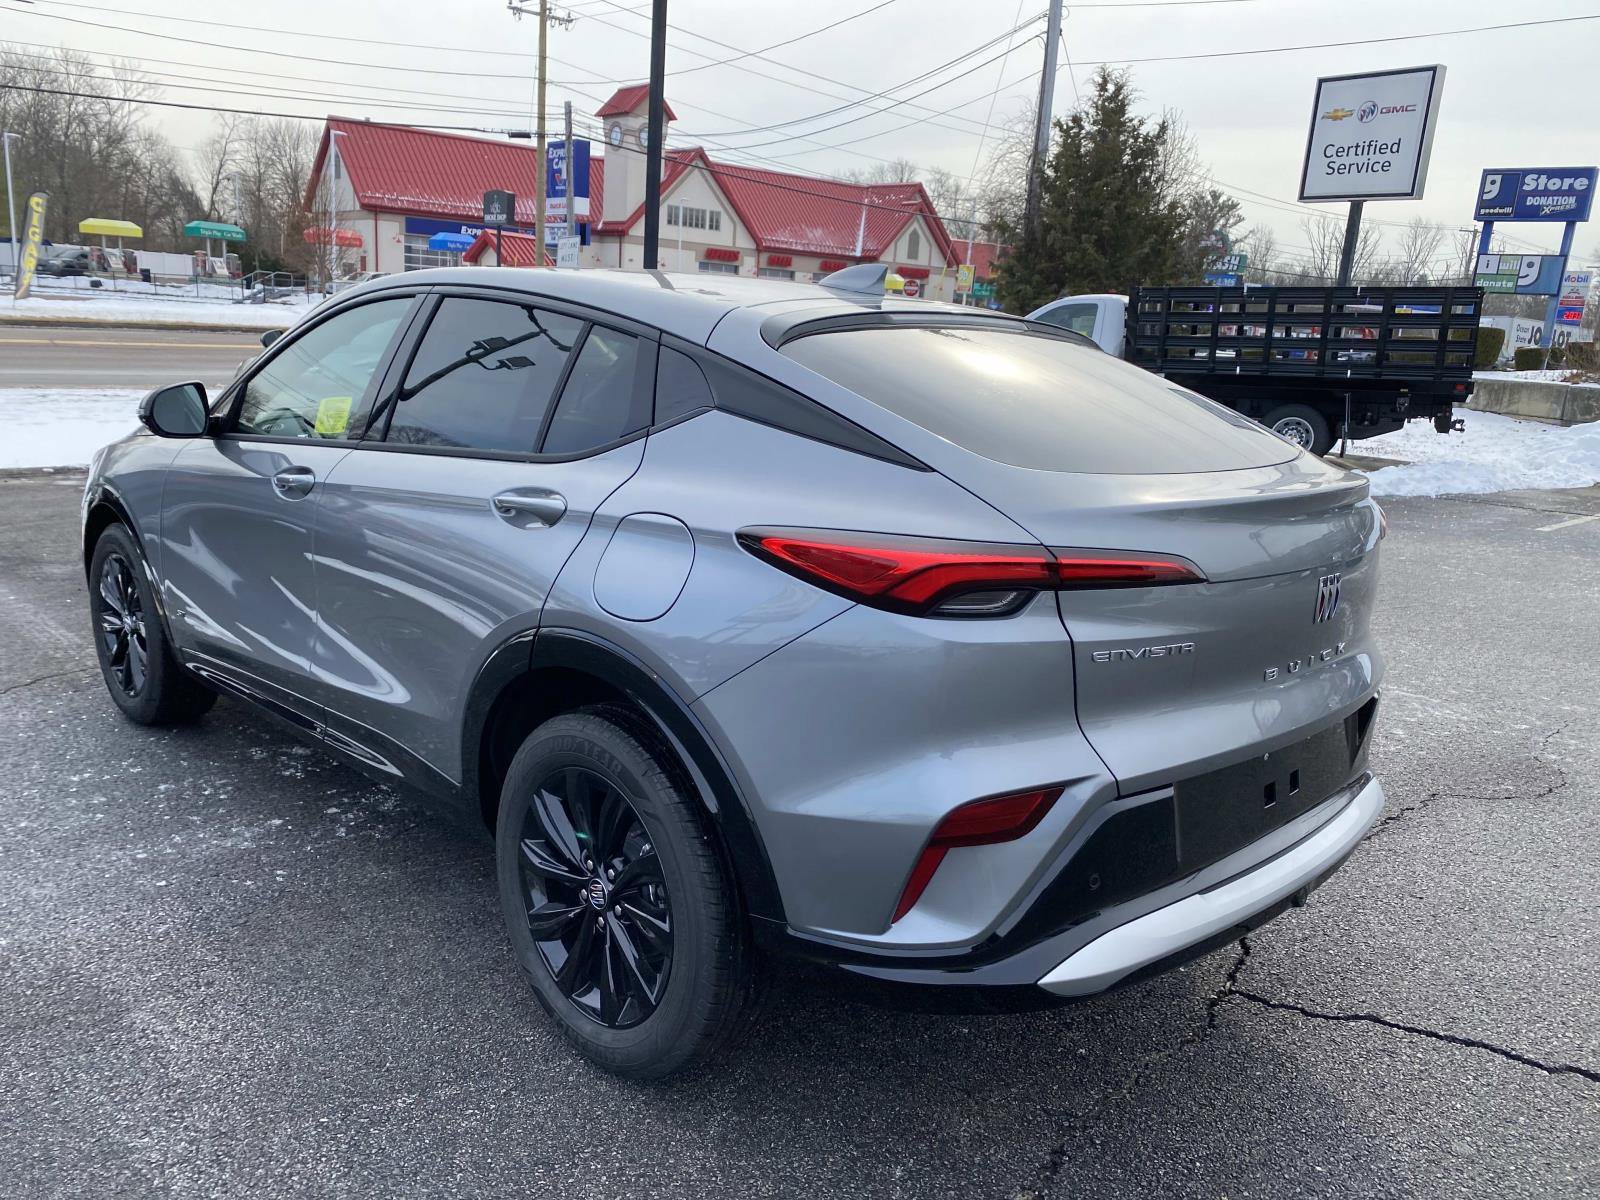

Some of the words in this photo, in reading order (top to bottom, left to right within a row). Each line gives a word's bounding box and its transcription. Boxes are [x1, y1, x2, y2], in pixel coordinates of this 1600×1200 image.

[1380, 104, 1417, 114] GMC
[1323, 137, 1402, 158] Certified
[1325, 158, 1391, 175] Service
[1522, 173, 1589, 191] Store
[1526, 196, 1577, 206] DONATION
[1480, 206, 1513, 214] goodwill
[1486, 260, 1490, 268] i
[1500, 260, 1521, 269] will
[1476, 278, 1514, 288] donate
[1562, 274, 1589, 283] Mobil
[1527, 325, 1543, 345] JO
[1091, 642, 1196, 664] ENVISTA
[1263, 641, 1346, 682] BUICK
